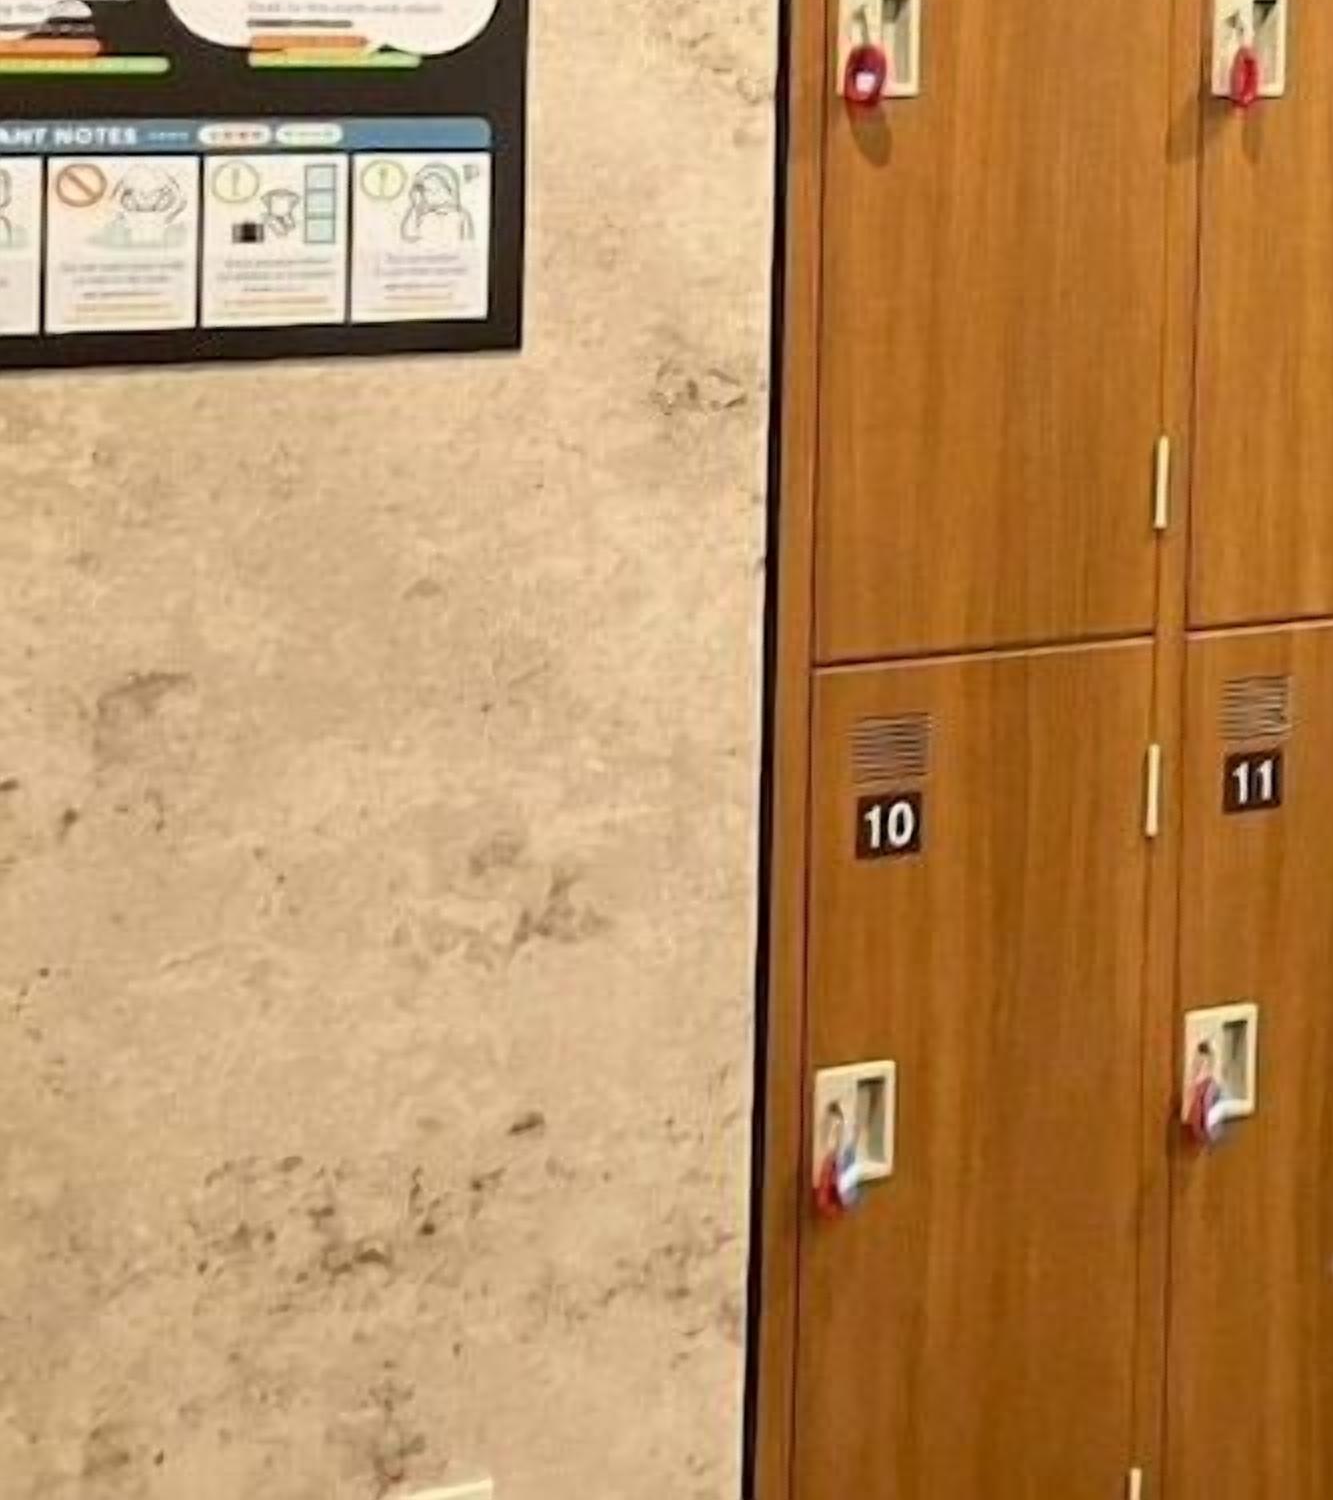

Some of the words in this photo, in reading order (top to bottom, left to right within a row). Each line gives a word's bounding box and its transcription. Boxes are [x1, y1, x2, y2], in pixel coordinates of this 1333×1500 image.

[55, 127, 137, 145] NOTES
[1233, 758, 1273, 804] 11
[864, 801, 915, 848] 10
